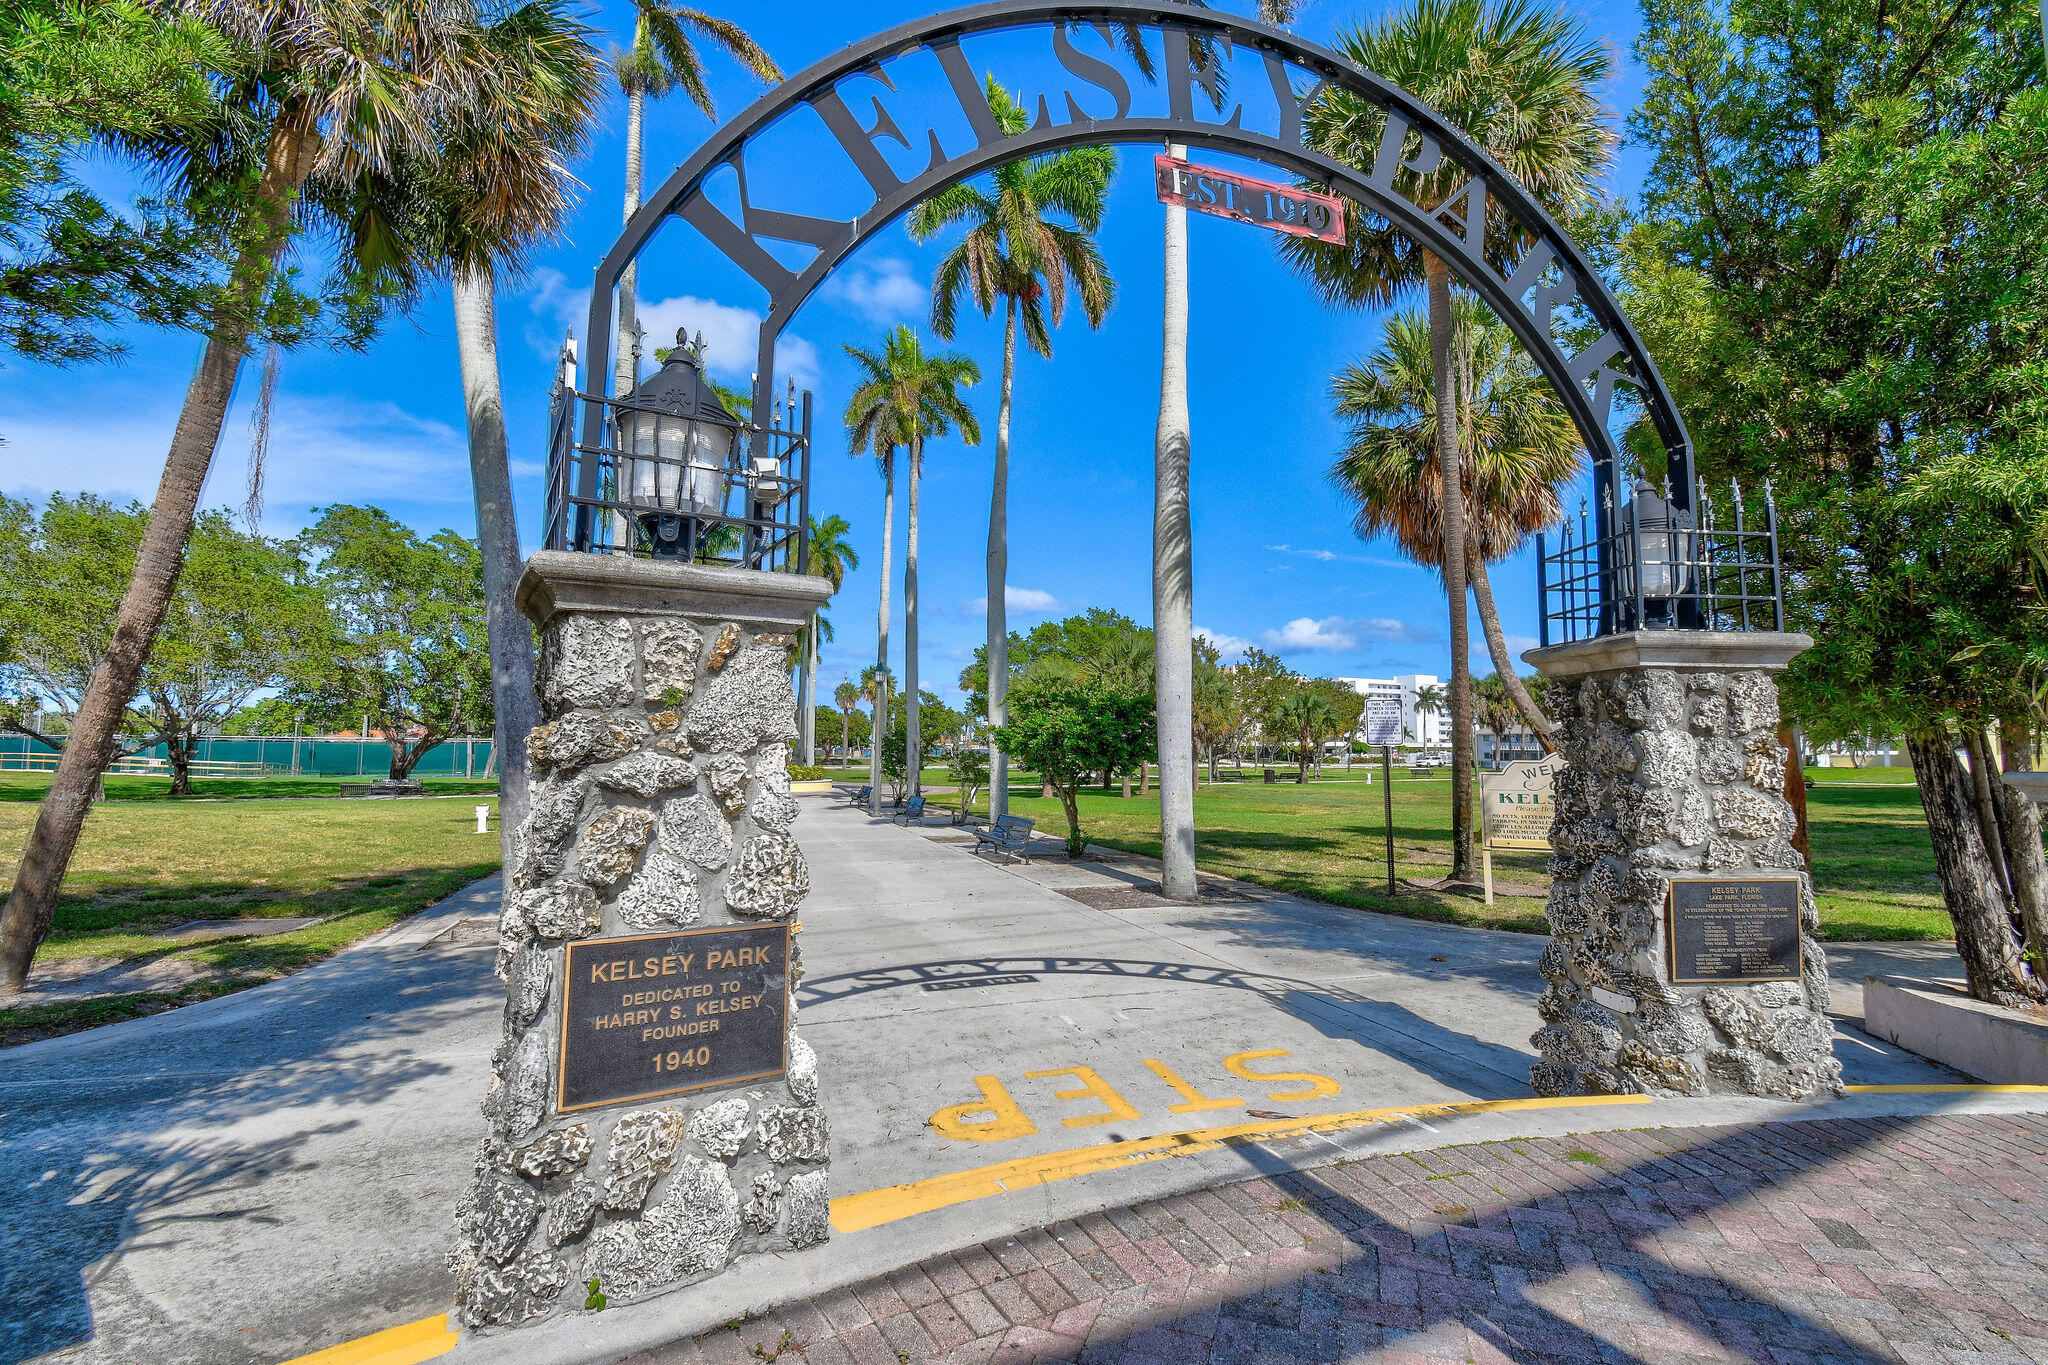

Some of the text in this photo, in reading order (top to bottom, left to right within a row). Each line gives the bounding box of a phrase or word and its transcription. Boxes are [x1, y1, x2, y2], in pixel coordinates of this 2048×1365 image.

[1172, 168, 1252, 214] EST.
[670, 20, 1648, 437] KELSEY PARK
[591, 945, 771, 984] KELSEY PARK
[596, 995, 762, 1030] HARRY S. KELSEY
[622, 981, 741, 1007] DEDICATED TO
[642, 1020, 719, 1042] FOUNDER
[652, 1047, 710, 1073] 1940
[928, 1048, 1342, 1142] STEP
